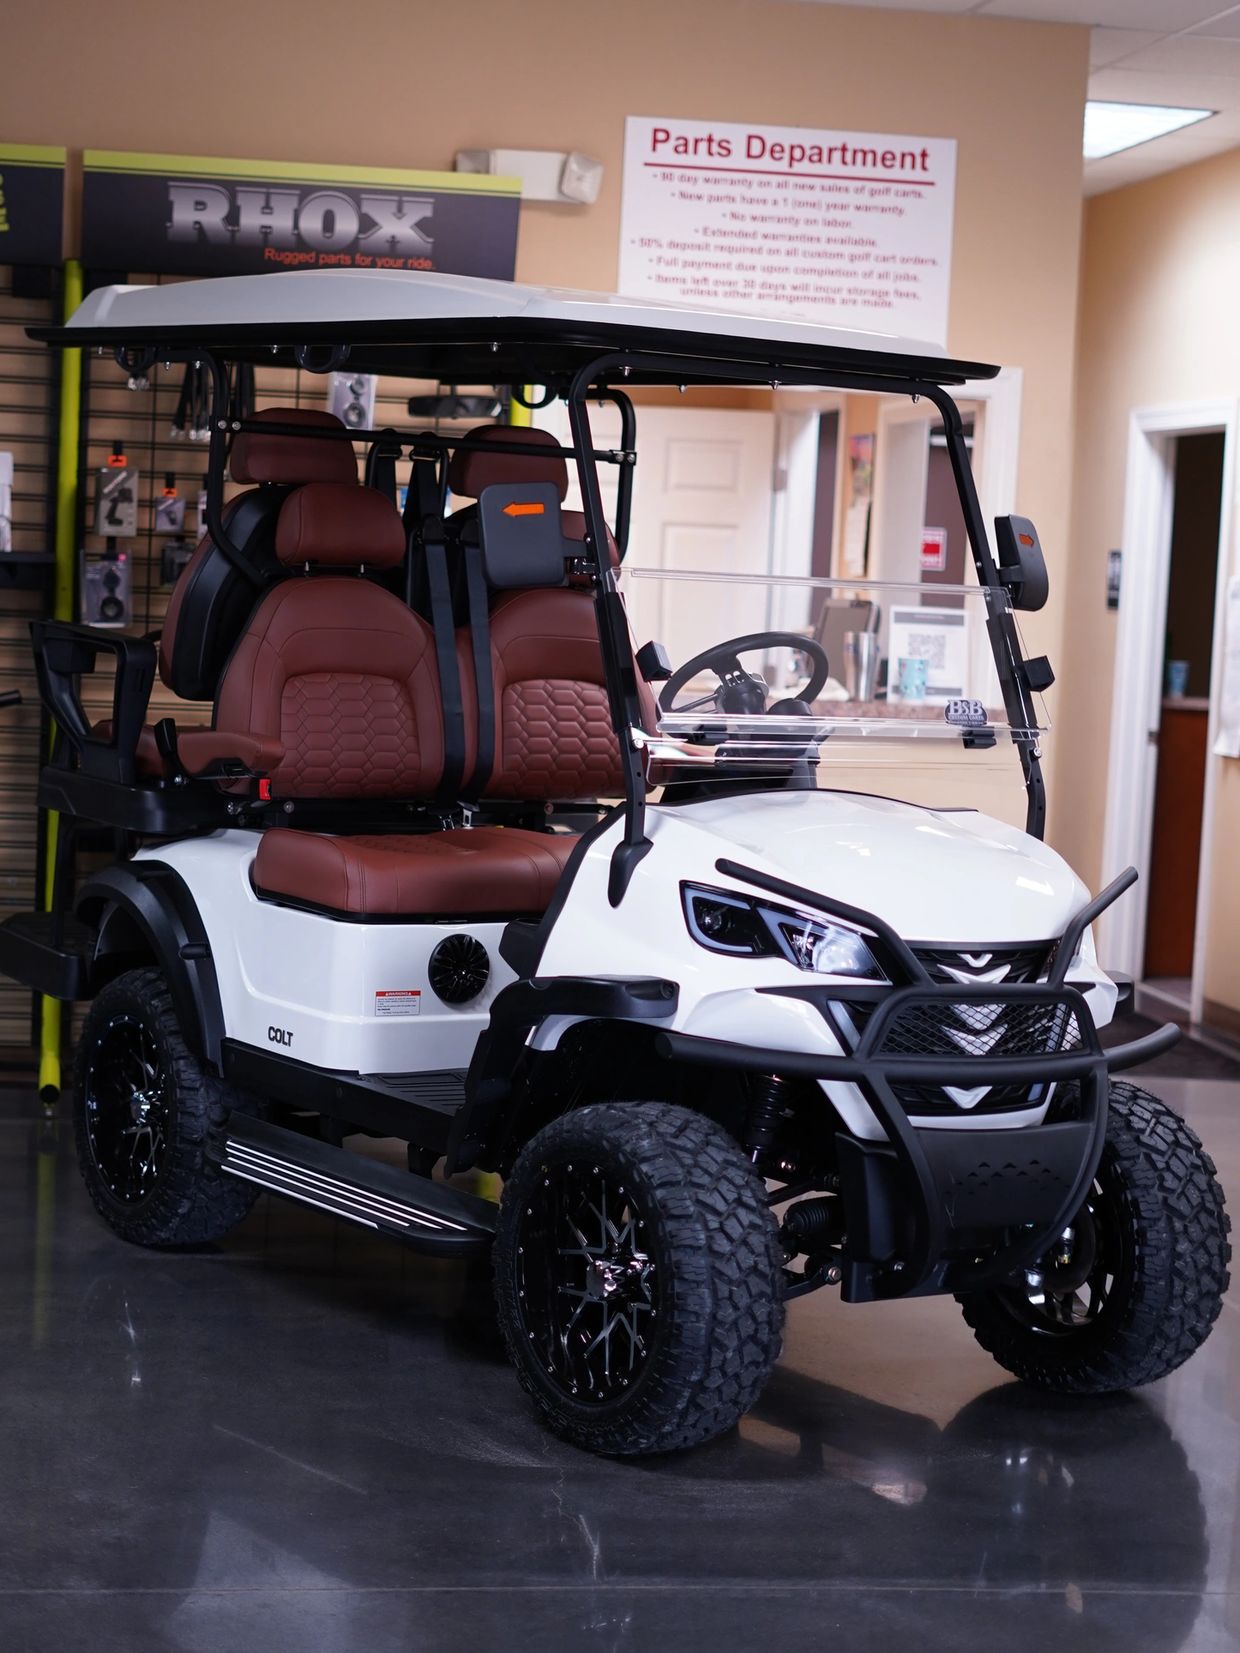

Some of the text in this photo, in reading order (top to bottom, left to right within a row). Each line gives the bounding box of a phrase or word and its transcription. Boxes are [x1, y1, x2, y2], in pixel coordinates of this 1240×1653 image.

[653, 128, 929, 171] Parts Department
[660, 171, 925, 199] 90 day warranty on all new sales of golf carts.
[678, 191, 703, 200] New
[707, 193, 736, 204] parts
[741, 195, 767, 204] have
[792, 198, 822, 210] (one)
[826, 203, 849, 212] year
[165, 181, 436, 254] RHOX
[730, 212, 746, 220] No
[750, 213, 800, 226] warranty
[703, 227, 758, 239] Extended
[761, 231, 820, 243] warranties
[264, 248, 316, 264] Rugged
[319, 251, 352, 266] parts
[355, 253, 373, 266] for
[375, 256, 405, 270] your
[667, 240, 710, 253] deposit
[714, 243, 763, 257] required
[785, 248, 798, 257] all
[803, 249, 844, 260] custom
[848, 252, 871, 264] golf
[874, 254, 896, 263] cart
[656, 256, 678, 266] Full
[682, 258, 732, 271] payment
[736, 262, 756, 271] due
[761, 265, 788, 275] upon
[793, 265, 857, 280] completion
[862, 270, 873, 279] of
[878, 271, 890, 280] all
[656, 273, 686, 284] Items
[691, 276, 710, 285] left
[713, 279, 738, 287] over
[760, 280, 786, 292] days
[791, 282, 810, 292] will
[816, 284, 842, 294] incur
[848, 286, 890, 299] storage
[680, 287, 718, 297] unless
[723, 289, 752, 300] other
[757, 292, 836, 307] arrangements
[841, 299, 857, 307] are
[268, 1026, 294, 1047] COLT
